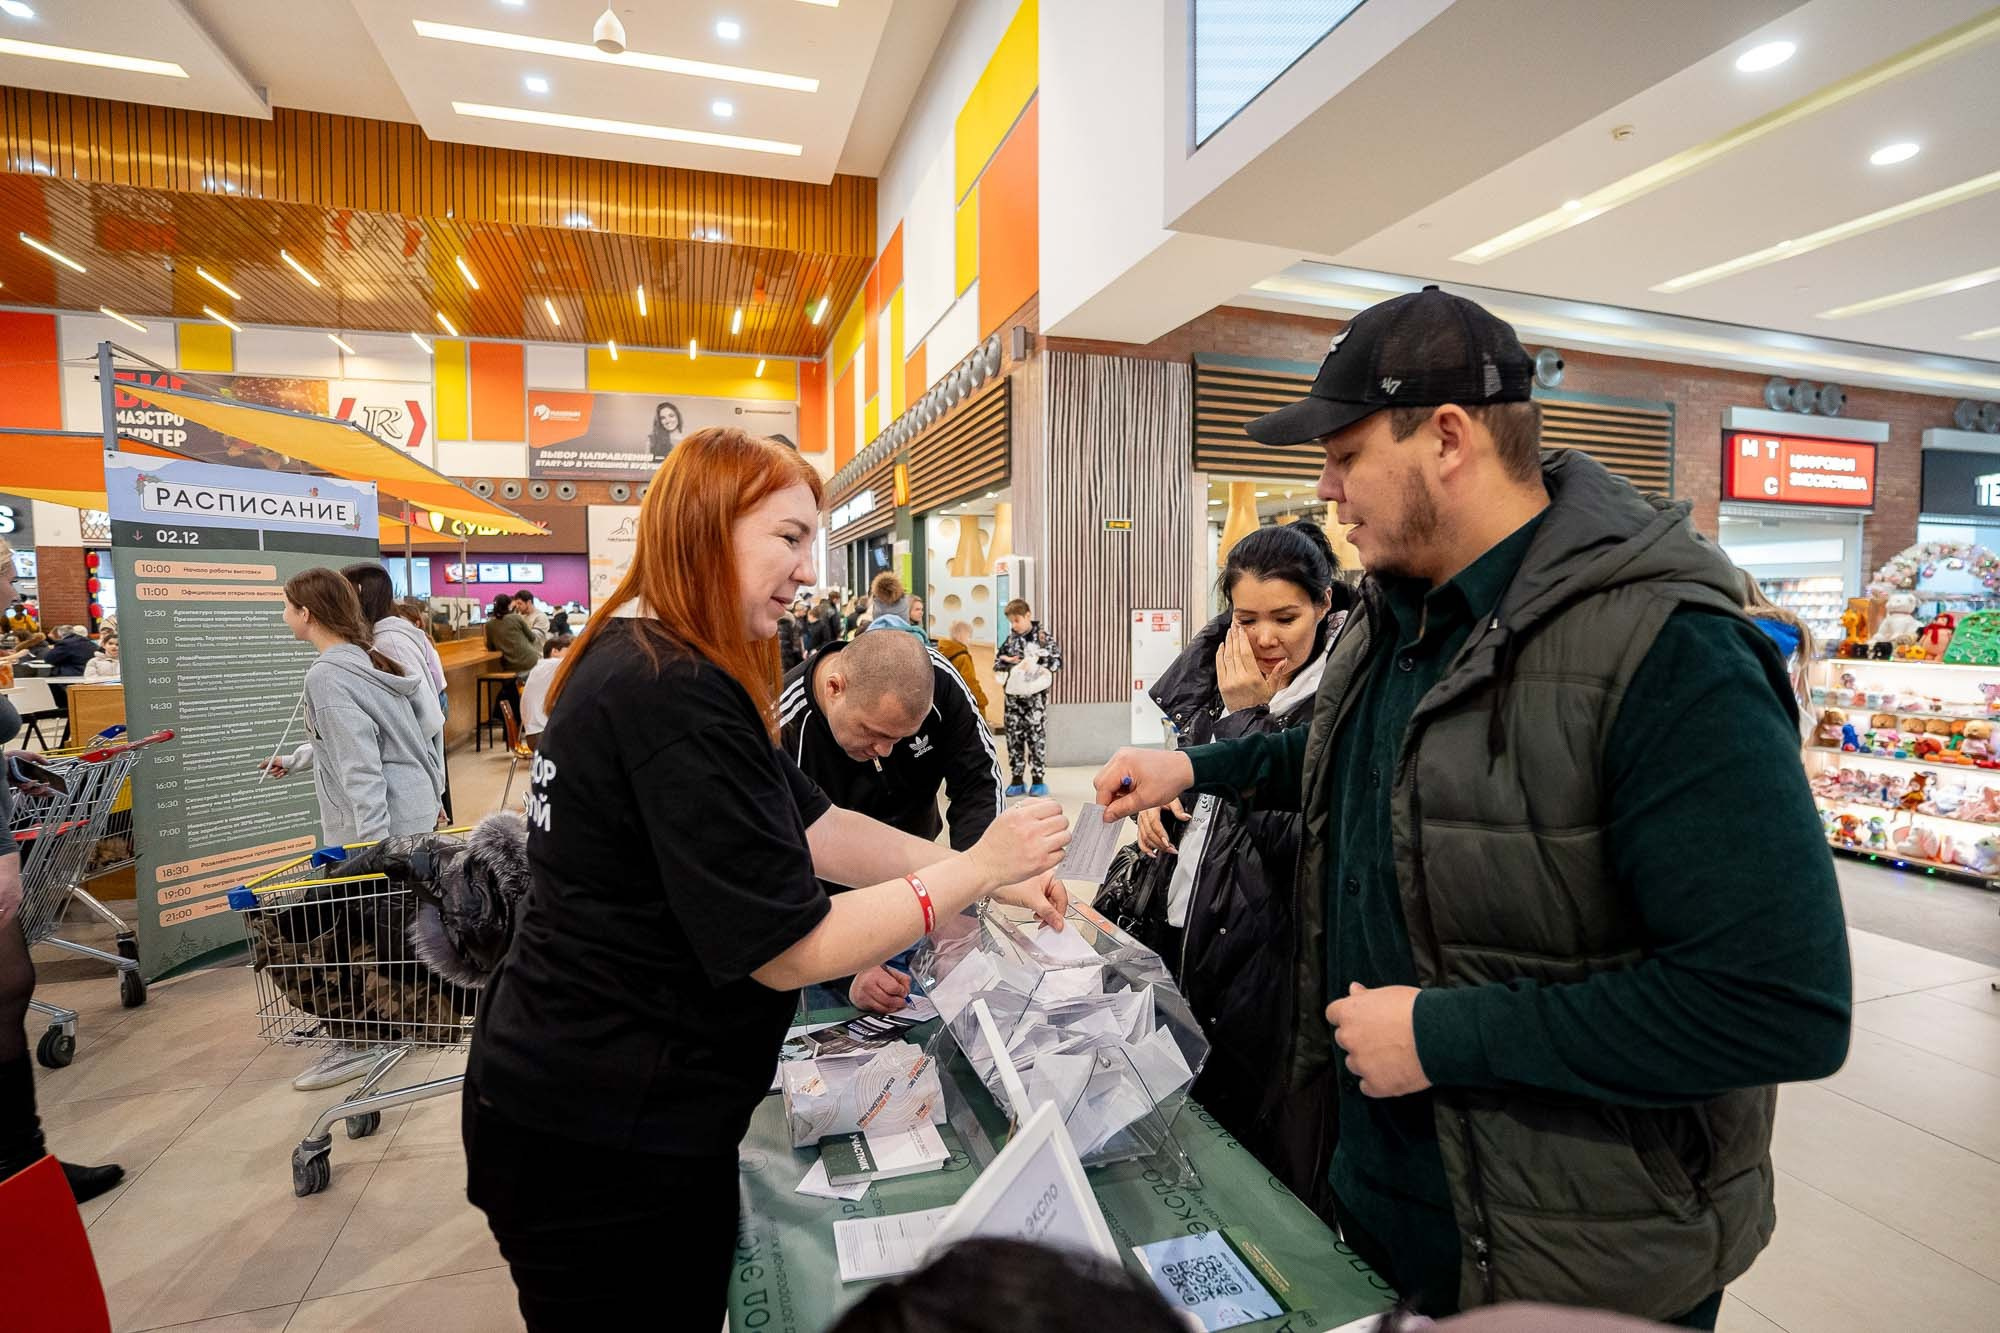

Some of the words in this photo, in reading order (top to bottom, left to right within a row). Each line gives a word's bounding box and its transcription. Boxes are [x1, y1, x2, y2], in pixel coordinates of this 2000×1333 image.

[116, 410, 185, 427] МАЭСТРО
[540, 450, 578, 459] ВЫБОР
[579, 451, 654, 462] НАПРАВЛЕНИЯ
[535, 459, 575, 468] START-UP
[576, 460, 583, 468] В
[584, 461, 629, 470] УСПЕШНОЕ
[155, 486, 348, 521] РАСПИСАНИЕ
[155, 529, 200, 545] 02.12
[141, 563, 171, 574] 10:00
[183, 566, 208, 574] Начало
[209, 568, 232, 576] работы
[142, 587, 169, 597] 11:00
[181, 588, 226, 597] Официальное
[144, 609, 167, 617] 12:30
[145, 636, 169, 645] 13:00
[146, 655, 170, 665] 13:30
[148, 676, 172, 685] 14:00
[150, 701, 173, 711] 14:30
[914, 744, 934, 758] adidas
[153, 753, 176, 764] 15:30
[155, 780, 178, 790] 16:00
[156, 799, 180, 810] 16:30
[158, 826, 181, 837] 17:00
[200, 851, 255, 869] Развлекательная
[254, 845, 287, 858] программа
[162, 864, 190, 878] 18:30
[203, 877, 236, 890] Розыгрыш
[164, 886, 192, 900] 19:00
[165, 908, 193, 923] 21:00
[849, 1134, 872, 1172] УЧАСТНИК
[1024, 1182, 1059, 1229] ЭКСПО
[1141, 1168, 1210, 1238] ЭКСПО
